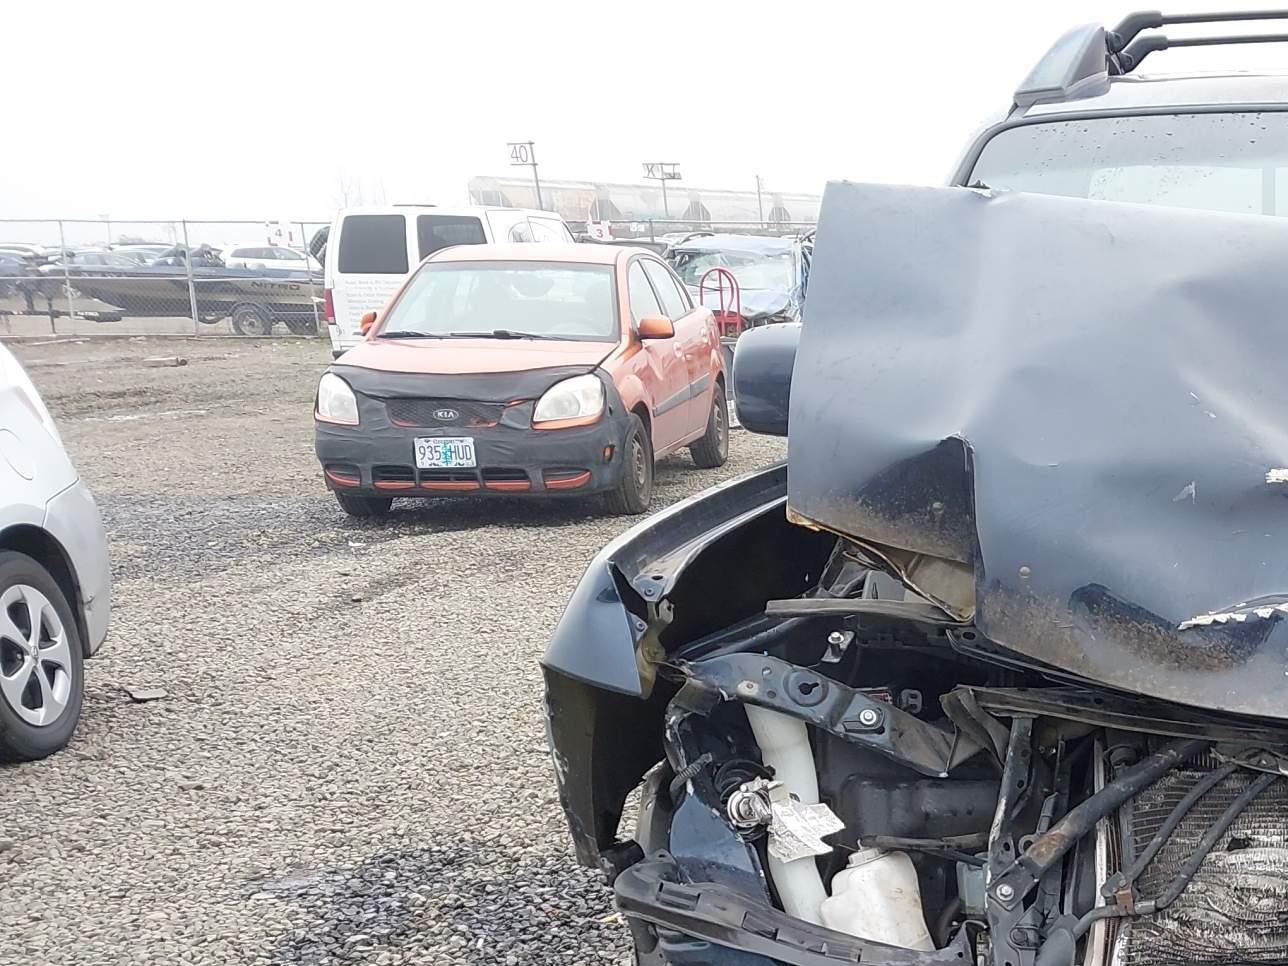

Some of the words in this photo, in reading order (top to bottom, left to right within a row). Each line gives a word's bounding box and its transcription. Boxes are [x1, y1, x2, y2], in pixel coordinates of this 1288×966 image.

[511, 144, 528, 162] 40
[595, 228, 604, 238] 3
[418, 445, 442, 461] 935
[449, 444, 472, 461] HUD
